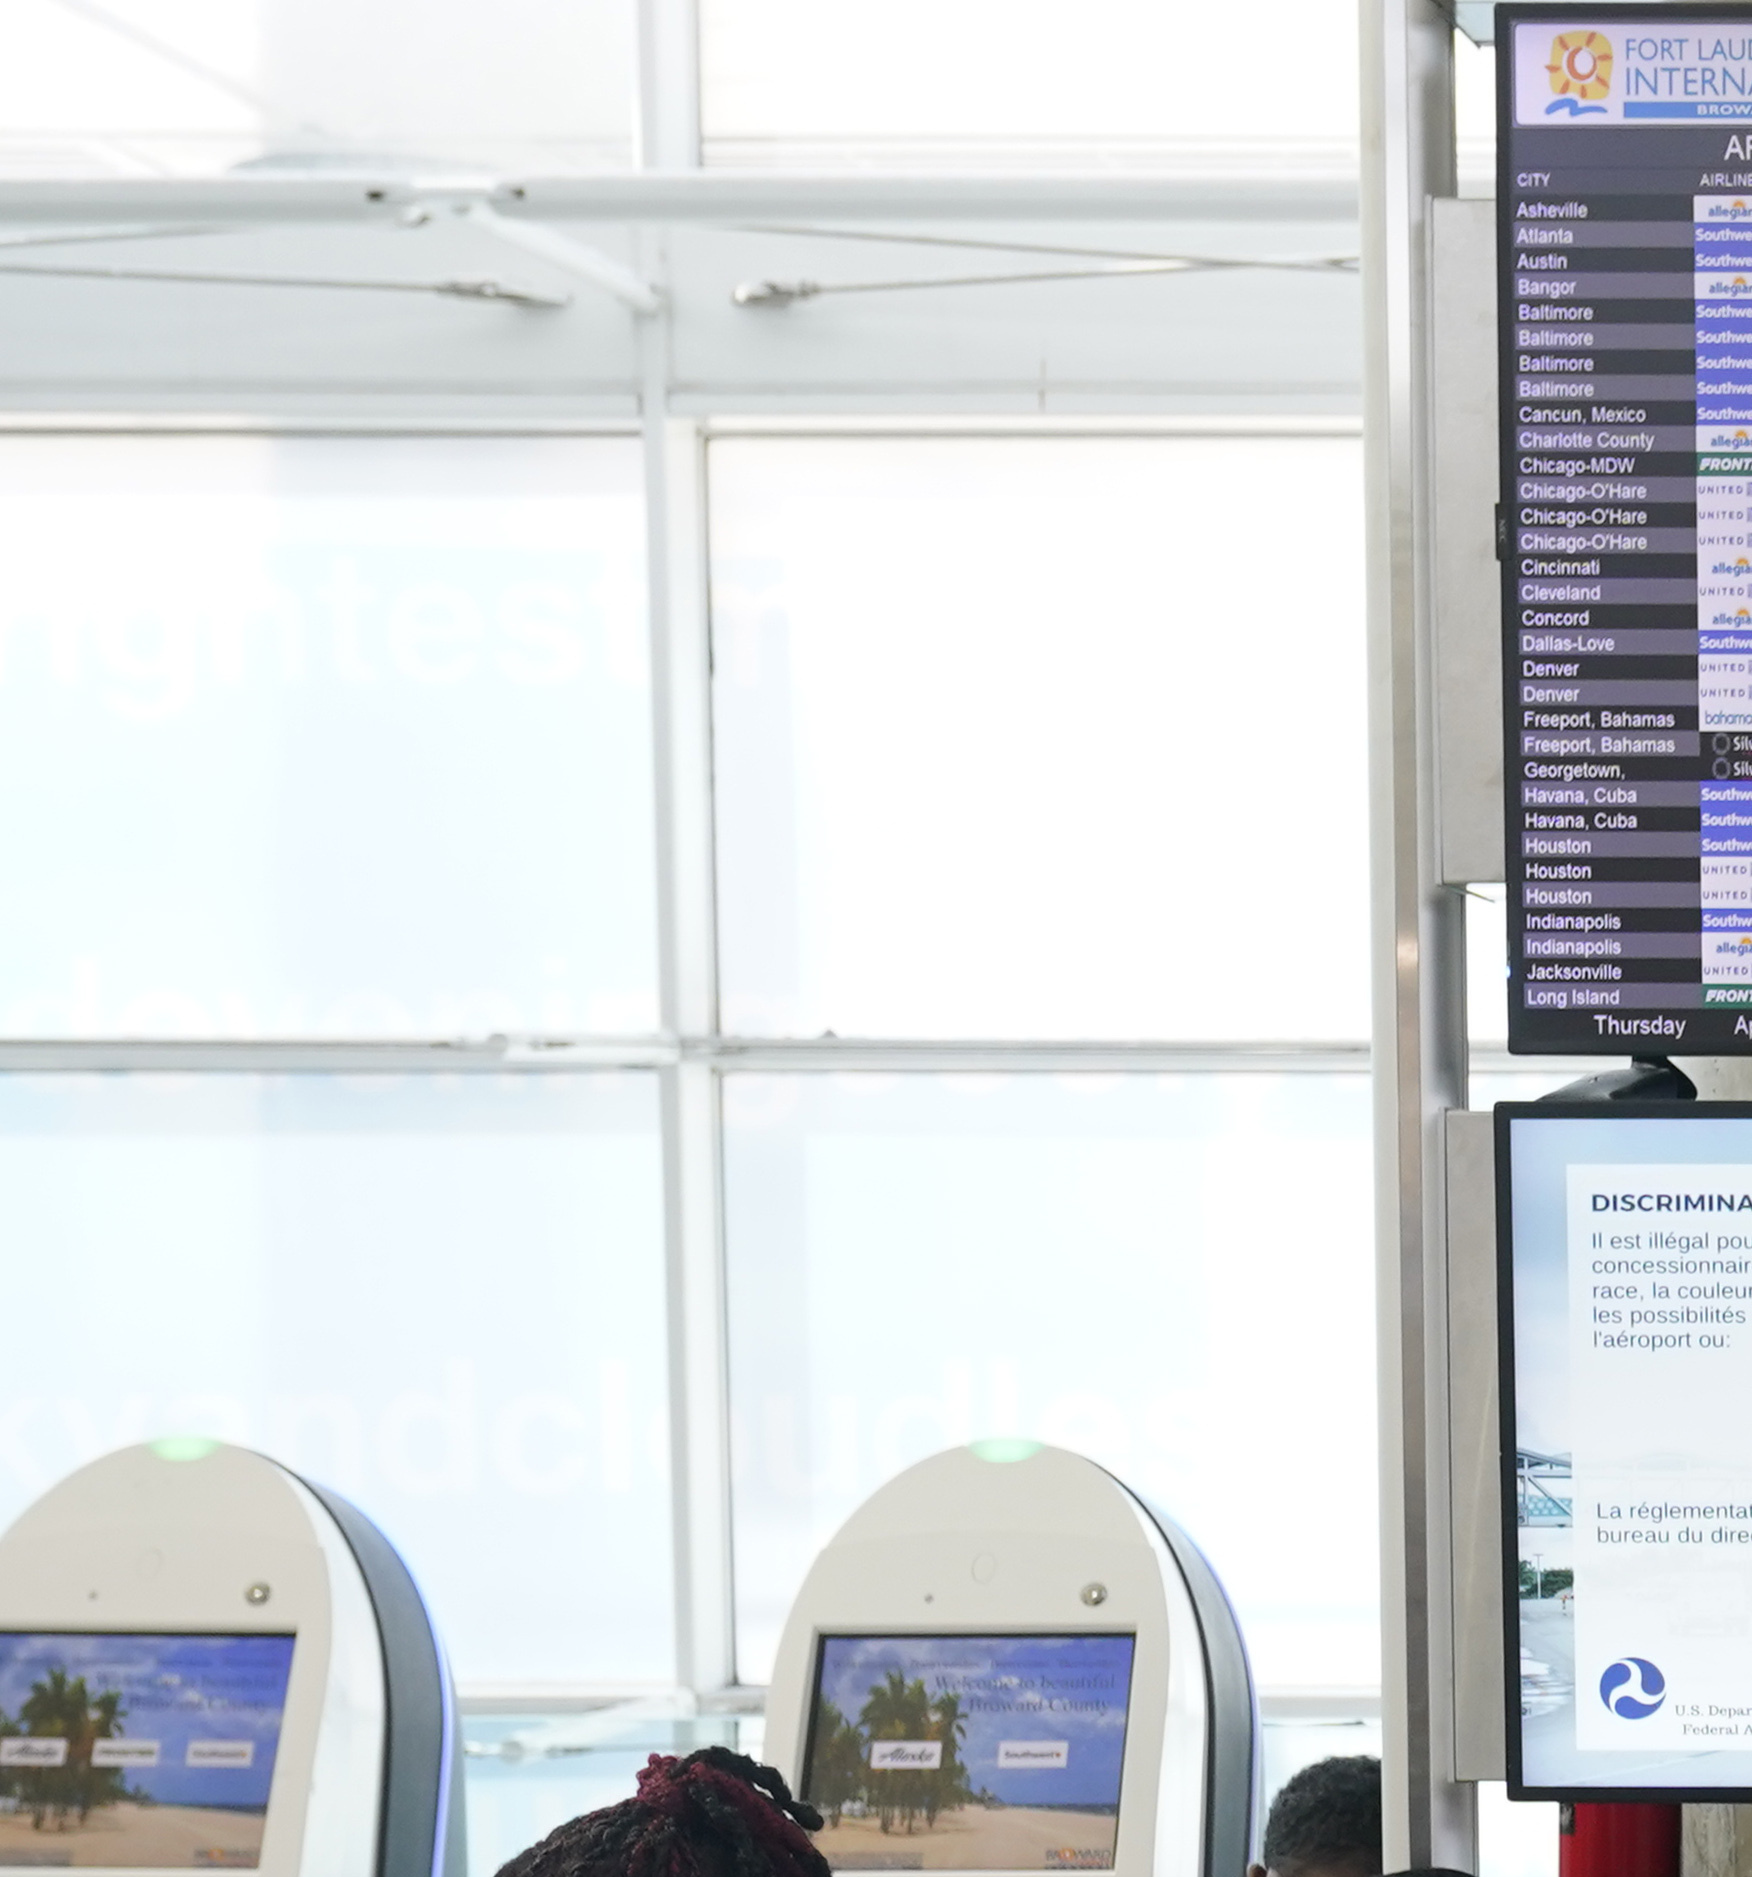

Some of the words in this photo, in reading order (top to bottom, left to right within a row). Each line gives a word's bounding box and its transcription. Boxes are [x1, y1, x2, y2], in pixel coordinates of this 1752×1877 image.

[1626, 38, 1689, 60] FORT
[1528, 989, 1567, 1008] Long
[1572, 989, 1619, 1005] Island
[1594, 1015, 1686, 1039] Thursday
[935, 1674, 1011, 1688] Welcome
[1040, 1673, 1115, 1688] beautiful
[968, 1698, 1043, 1712] Broward
[1049, 1698, 1110, 1715] County
